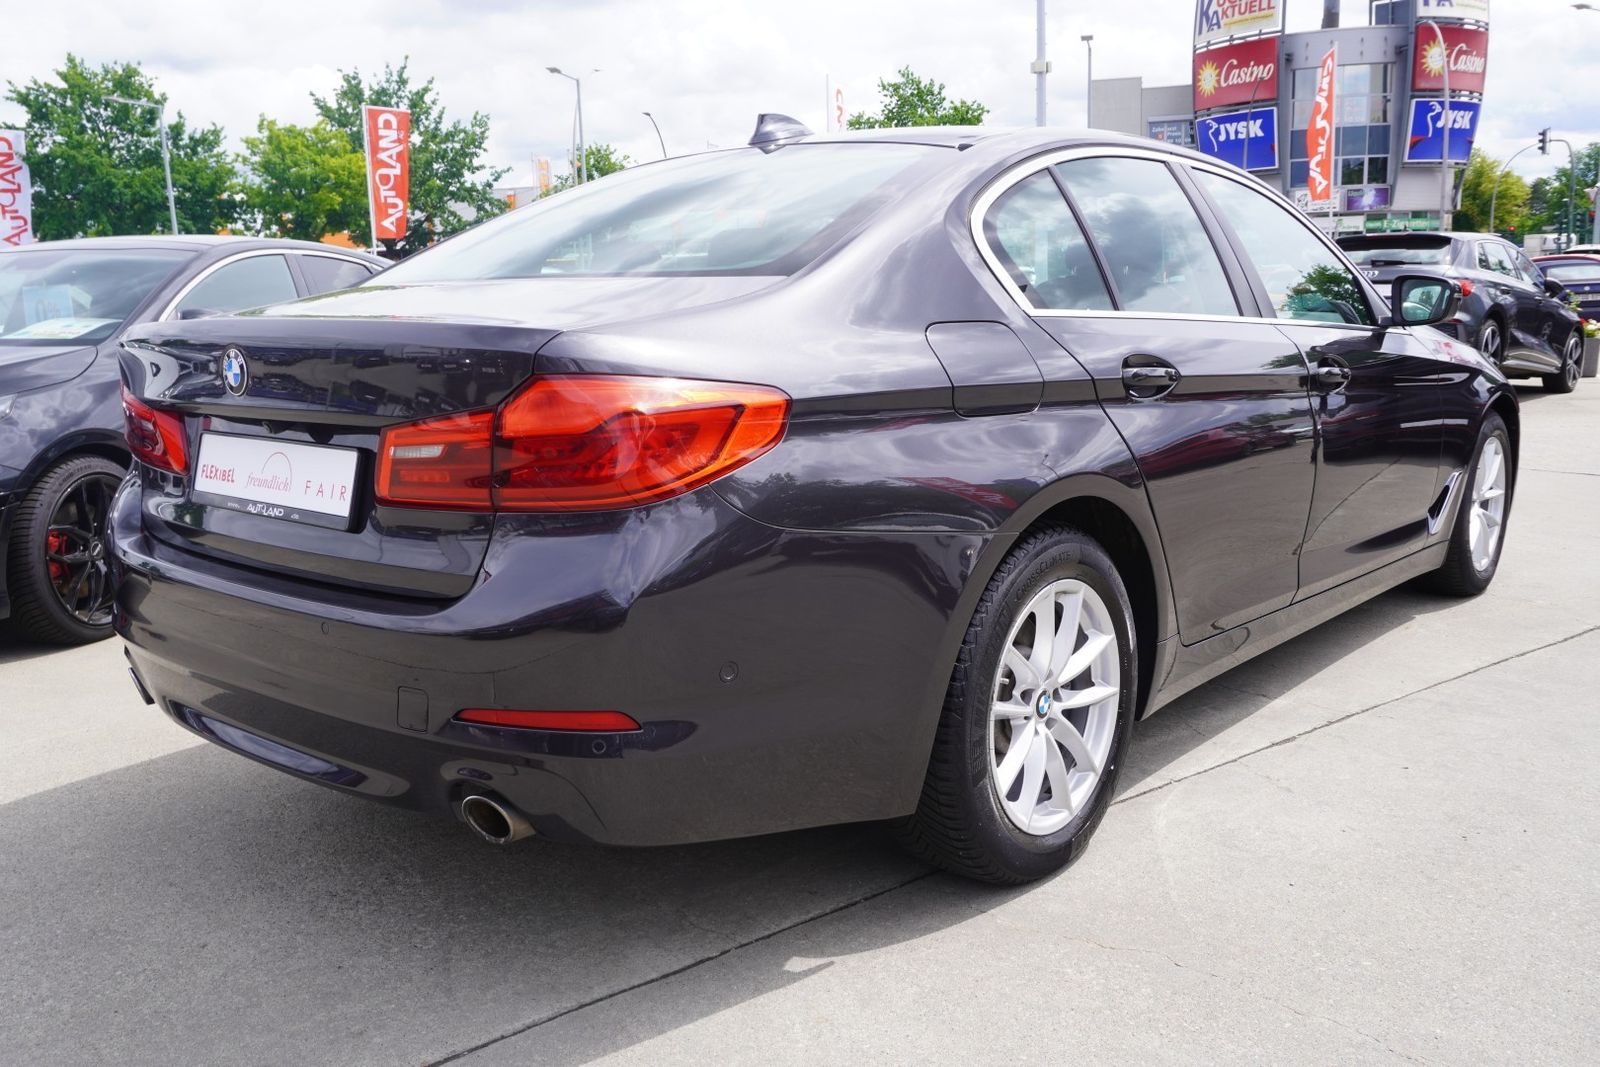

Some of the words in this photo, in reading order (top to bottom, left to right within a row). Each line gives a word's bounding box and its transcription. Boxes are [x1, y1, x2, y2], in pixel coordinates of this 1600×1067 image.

[1449, 43, 1485, 73] Casino
[1220, 58, 1274, 88] Casino
[1218, 118, 1265, 142] JYSK
[1436, 109, 1473, 129] JYSK
[375, 112, 404, 232] AUTOLAND
[201, 464, 235, 483] FLEXIBEL
[246, 472, 291, 492] freundlich
[247, 503, 285, 517] AUTOLAND
